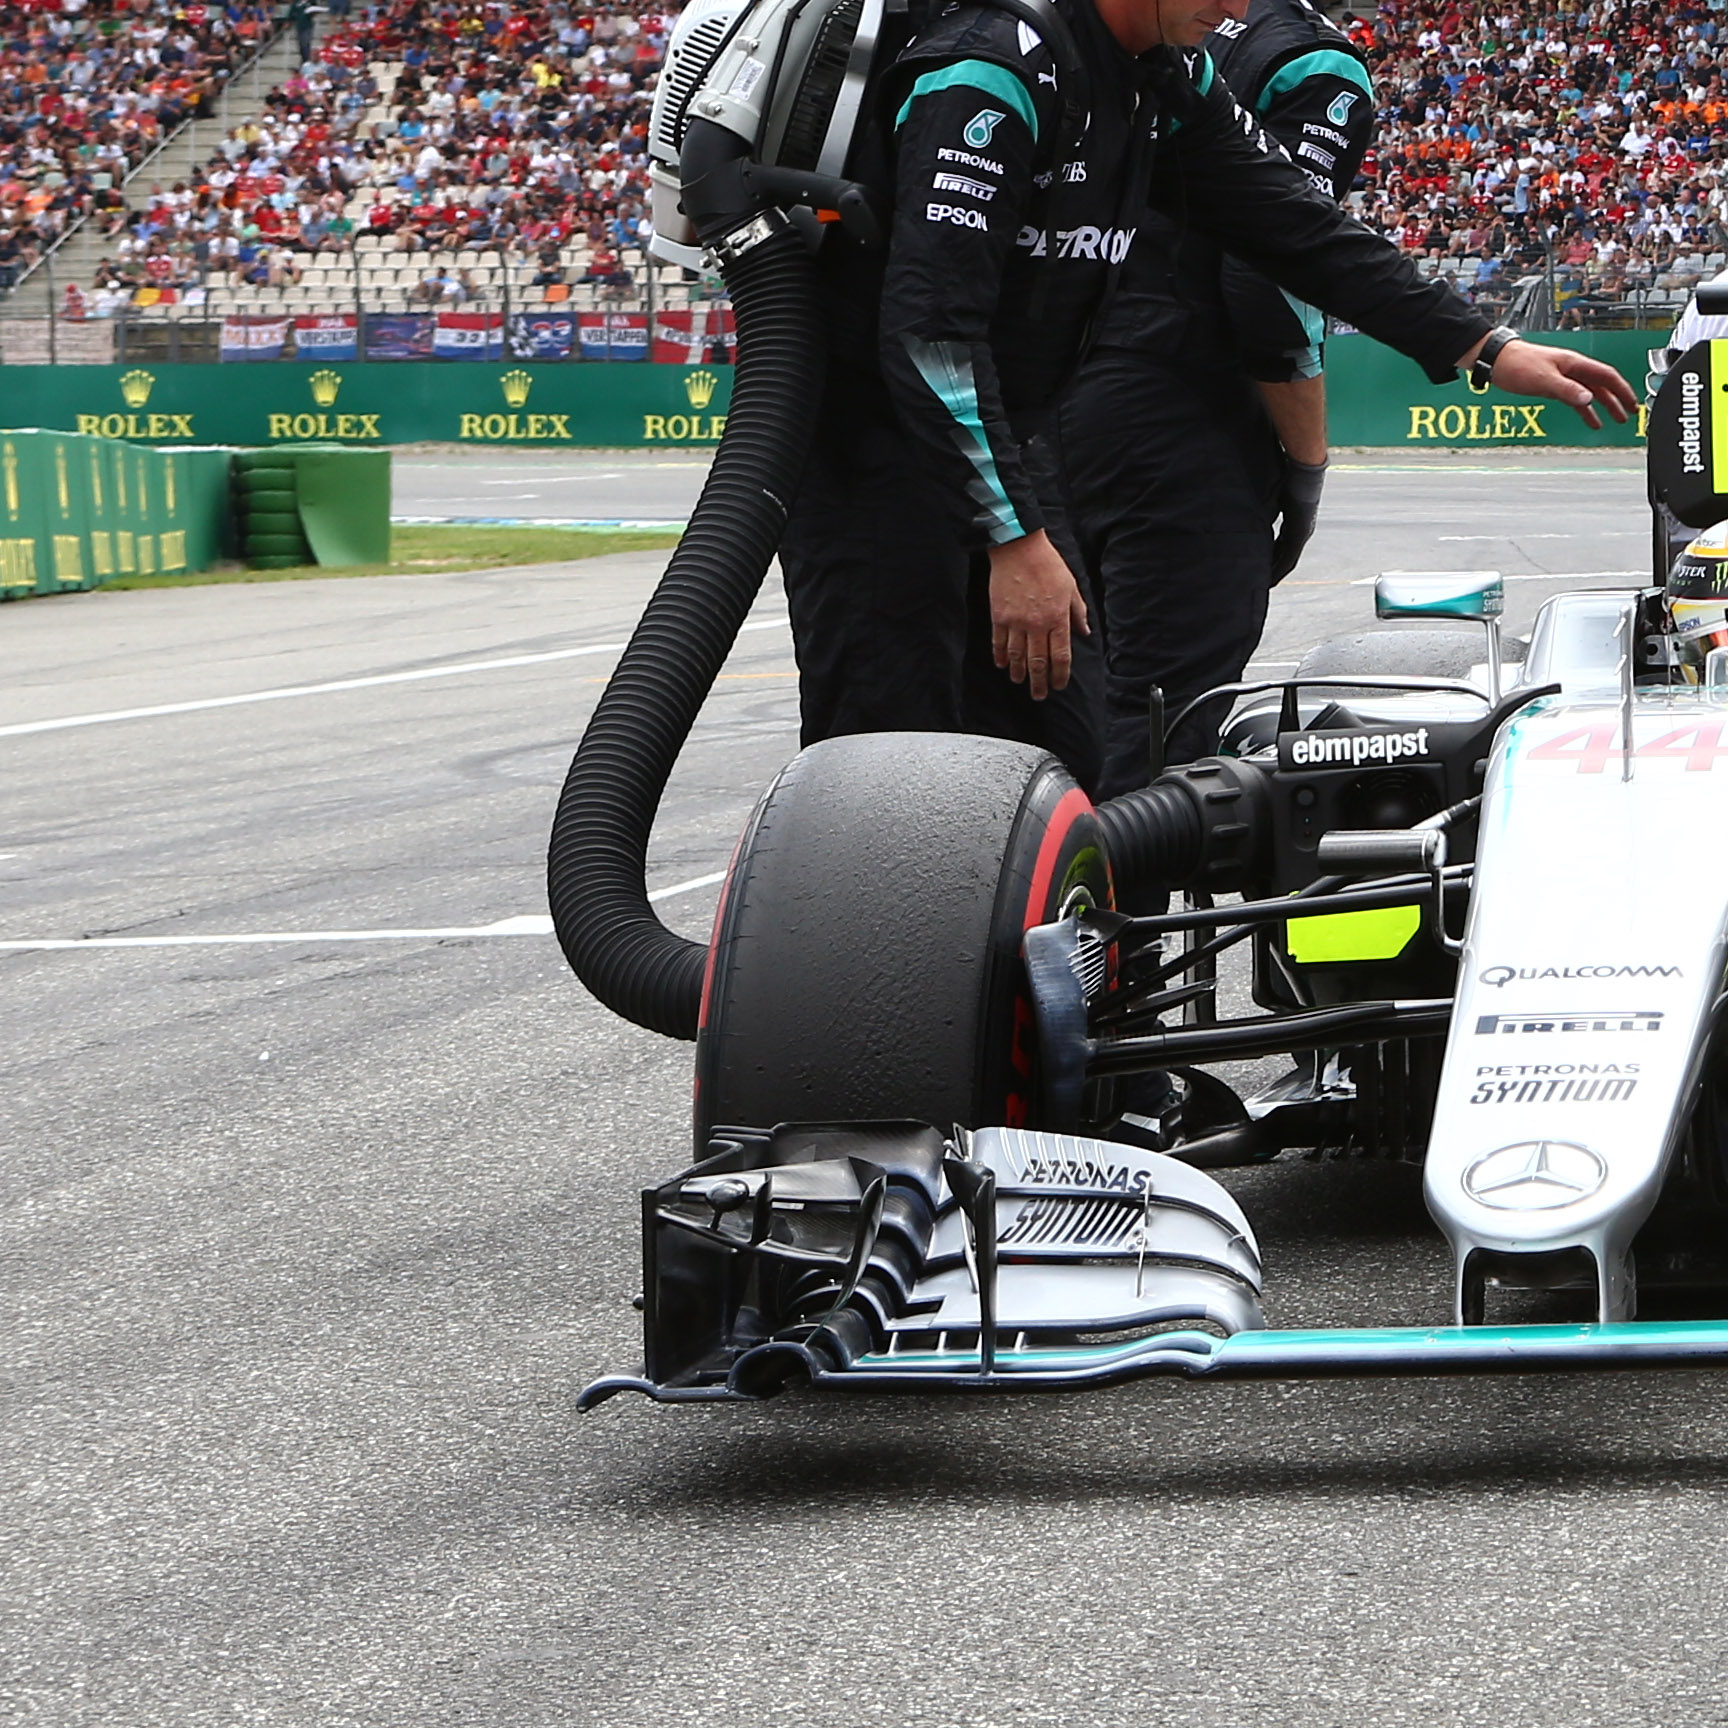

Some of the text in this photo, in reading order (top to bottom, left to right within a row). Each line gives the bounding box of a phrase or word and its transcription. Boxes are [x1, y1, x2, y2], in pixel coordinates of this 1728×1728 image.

[937, 147, 1004, 176] PETRONAS
[932, 171, 998, 202] PIRELLI
[926, 202, 989, 232] EPSON
[584, 329, 648, 344] VERTAPPEN
[76, 414, 195, 439] ROLEX
[267, 414, 382, 439] ROLEX
[459, 414, 573, 439] ROLEX
[643, 415, 729, 440] ROLE
[1407, 404, 1547, 440] ROLEX
[1678, 371, 1705, 474] ebmpapst
[1292, 728, 1429, 766] ebmpapst
[1478, 965, 1685, 988] QUALCOMM
[1474, 1011, 1665, 1036] PIRELLI
[1475, 1062, 1641, 1078] PETRONAS
[1469, 1077, 1638, 1105] SYNTIUM
[1019, 1158, 1153, 1195] PETRONAS
